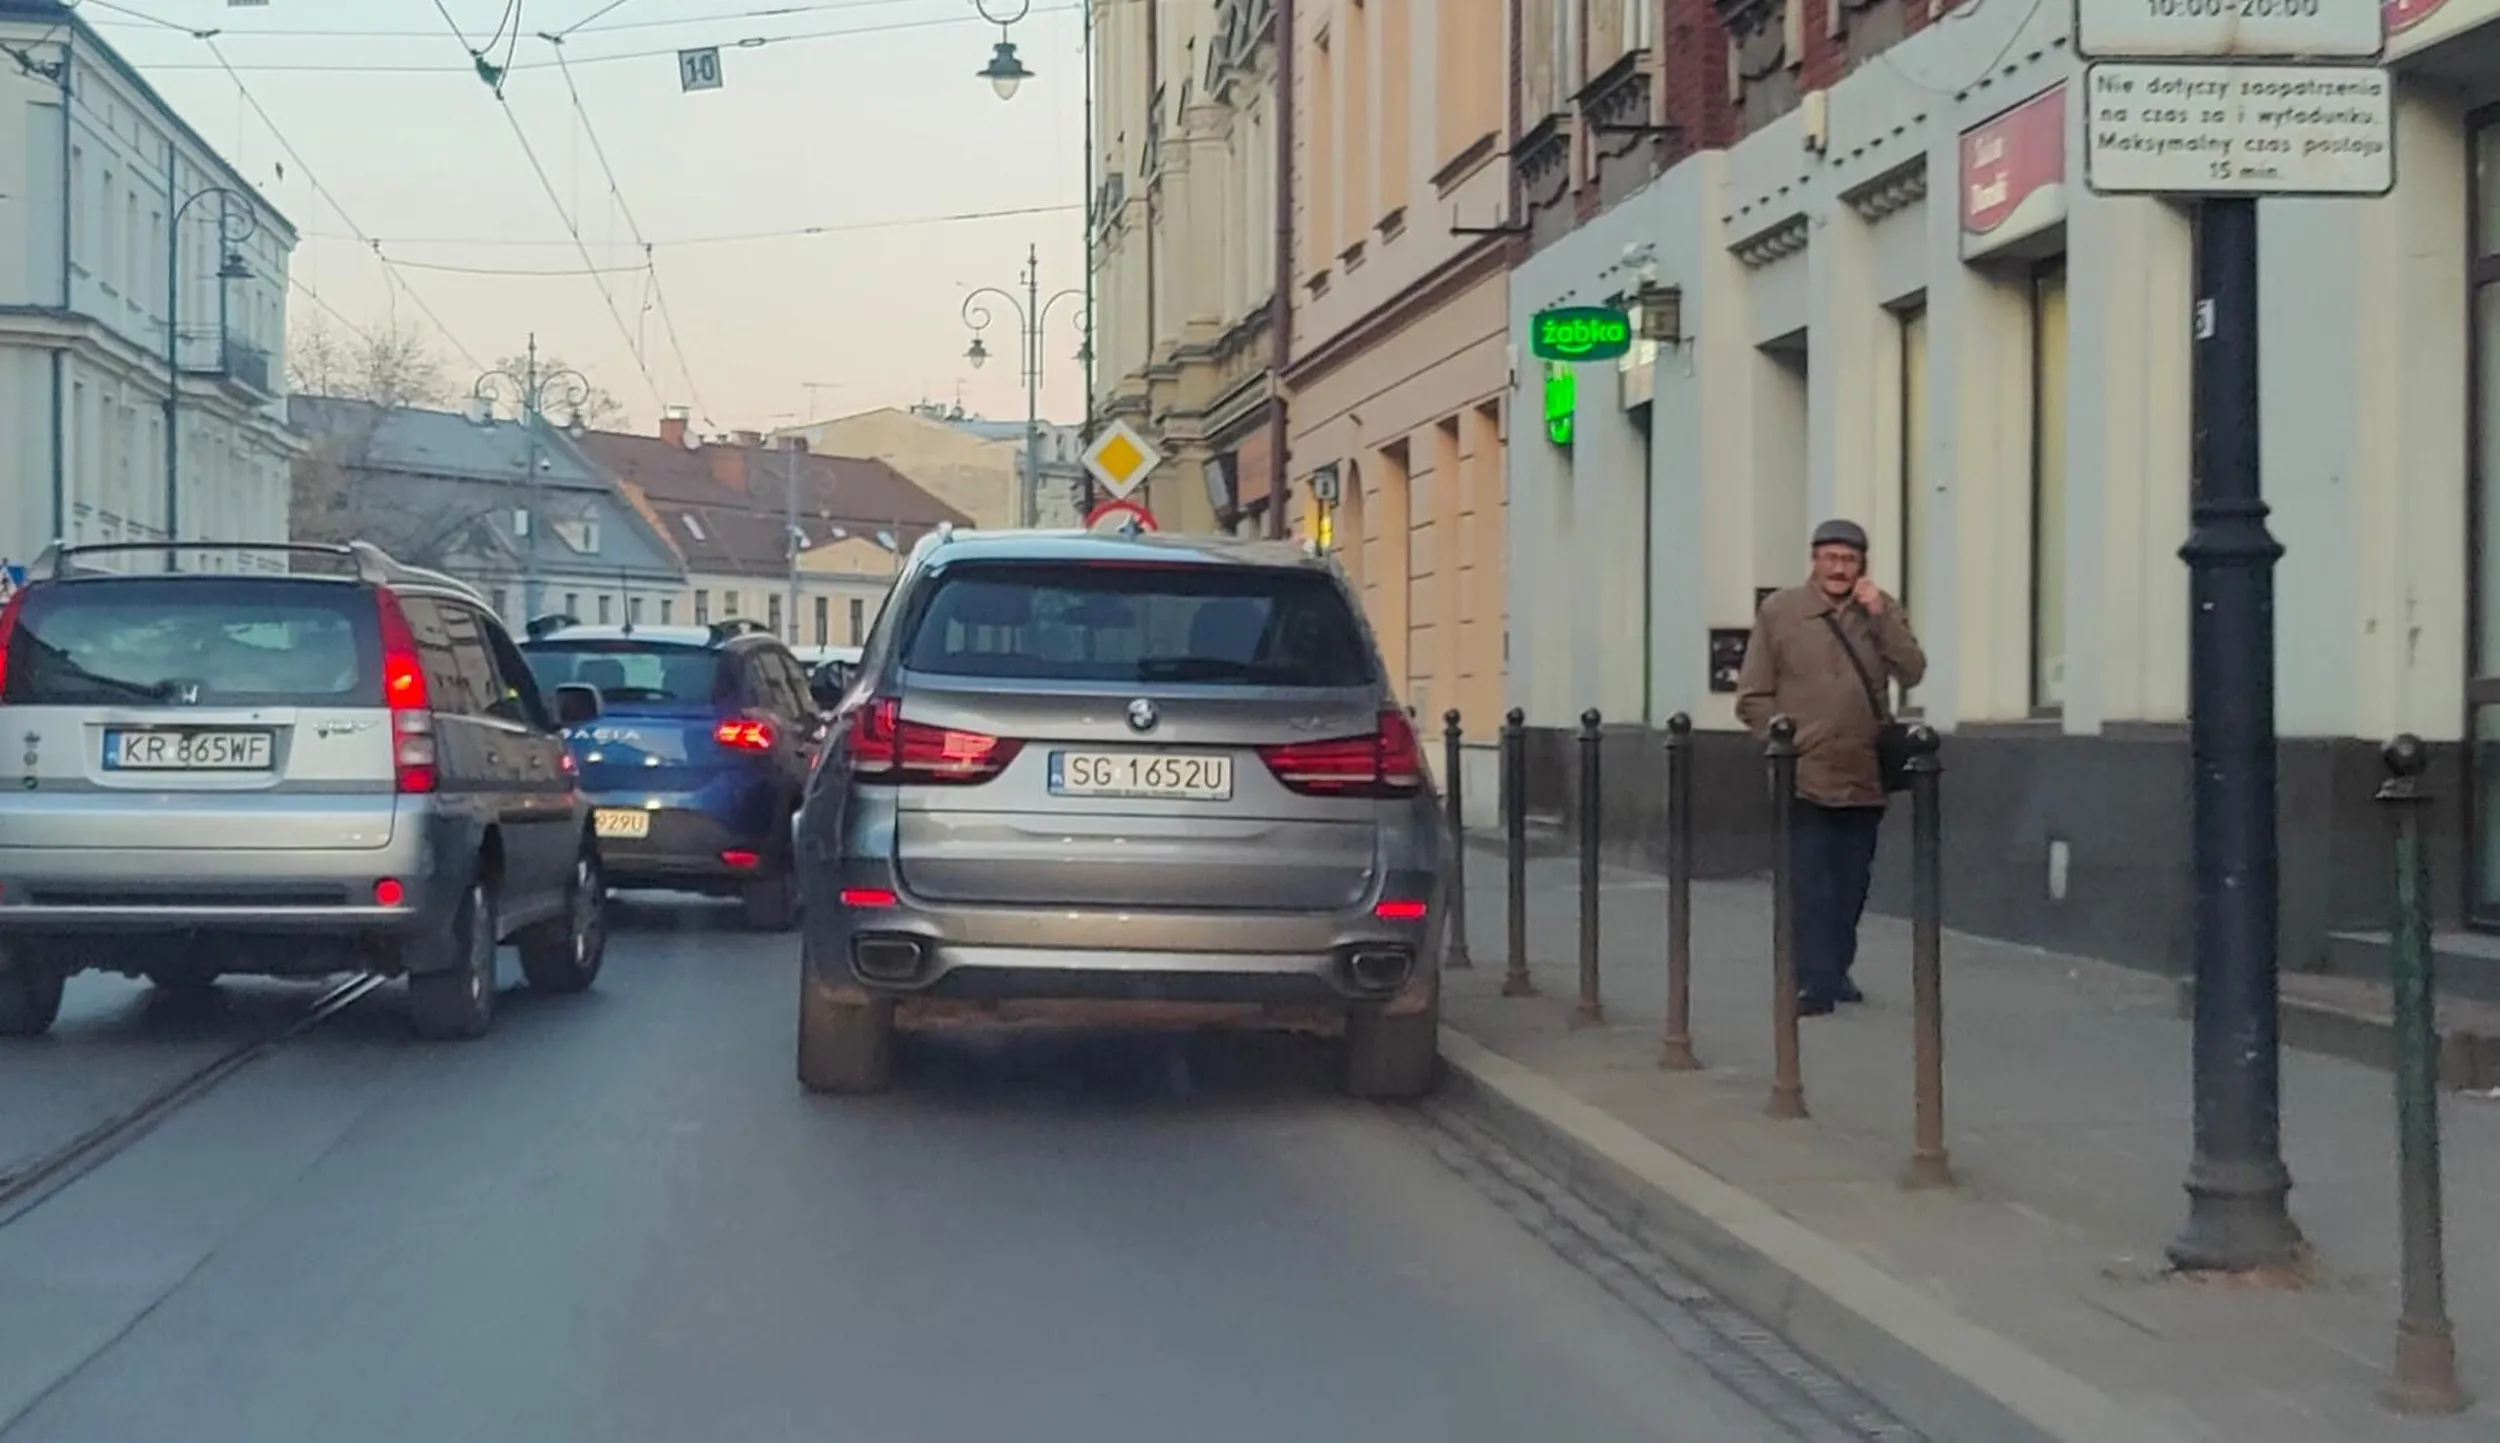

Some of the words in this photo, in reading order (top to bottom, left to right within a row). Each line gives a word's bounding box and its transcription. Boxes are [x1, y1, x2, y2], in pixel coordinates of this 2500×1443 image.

[2149, 0, 2318, 17] 10:00-20:00
[685, 54, 715, 83] 10
[2098, 75, 2134, 94] Nie
[2146, 77, 2230, 101] dotyczy
[2240, 77, 2382, 100] zaopatrzenia
[2100, 108, 2128, 123] na
[2142, 108, 2188, 123] czas
[2201, 108, 2226, 123] za
[2237, 105, 2245, 124] i
[2097, 132, 2233, 157] Maksymalny
[2244, 138, 2292, 153] czas
[2302, 136, 2382, 158] postoju
[2209, 160, 2232, 180] 15
[1542, 318, 1625, 345] żabka
[124, 736, 166, 763] KR
[176, 736, 268, 763] 865WF
[1072, 757, 1112, 786] SG
[1128, 758, 1222, 790] 1652U
